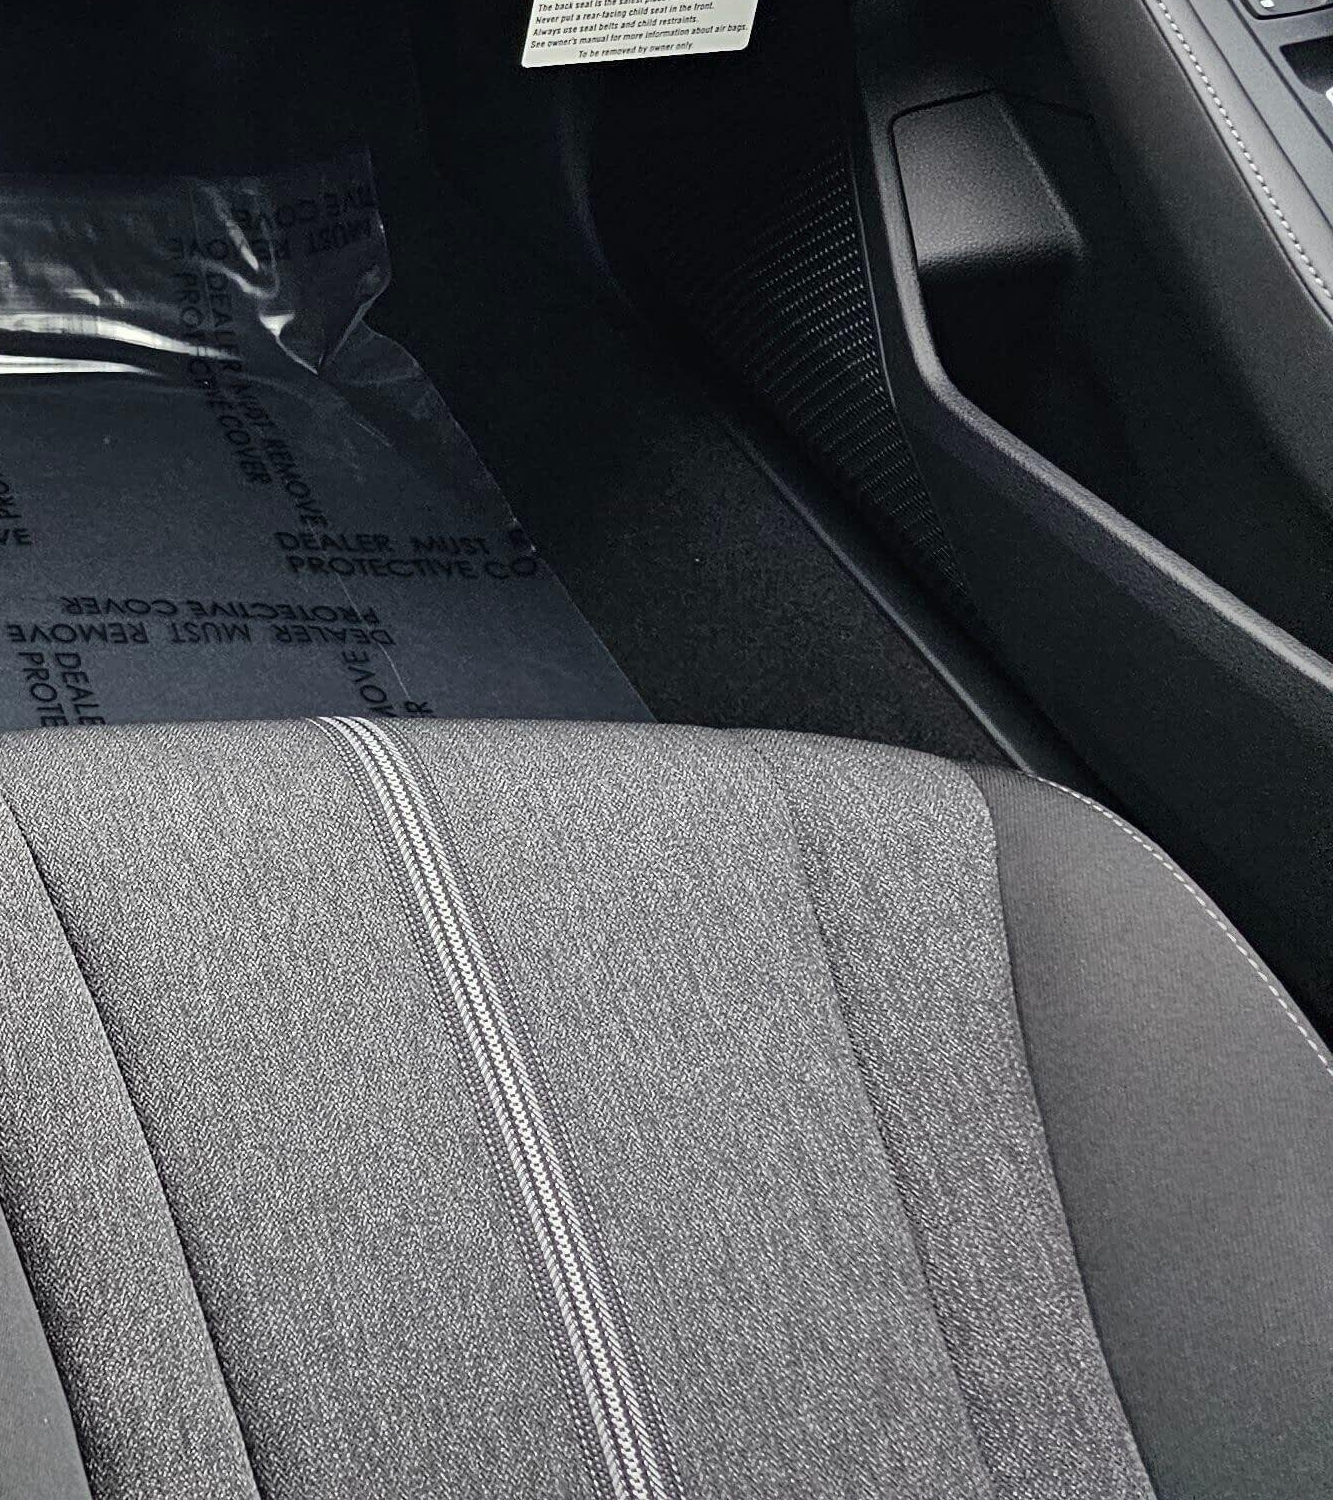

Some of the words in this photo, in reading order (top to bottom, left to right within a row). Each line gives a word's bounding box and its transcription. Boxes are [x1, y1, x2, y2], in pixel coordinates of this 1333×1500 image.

[535, 15, 558, 24] Never
[561, 13, 574, 23] put
[583, 8, 626, 20] rear-facing
[629, 7, 648, 16] child
[650, 6, 667, 14] seat
[669, 5, 677, 13] in
[679, 4, 691, 12] the
[538, 3, 552, 12] The
[555, 0, 573, 10] back
[575, 0, 593, 9] seat
[530, 39, 545, 49] See
[547, 37, 577, 47] owner's
[579, 34, 609, 44] manual
[611, 33, 621, 42] for
[623, 32, 644, 40] more
[645, 29, 689, 39] information
[691, 25, 713, 35] about
[715, 25, 726, 33] air
[727, 23, 749, 33] bags.
[533, 27, 561, 37] Always
[563, 26, 577, 34] use
[579, 23, 597, 32] seat
[599, 21, 618, 31] belts
[620, 20, 635, 29] and
[638, 18, 656, 27] child
[578, 50, 588, 58] To
[590, 49, 600, 58] be
[602, 45, 636, 56] removed
[638, 44, 647, 53] by
[649, 43, 674, 52] owner
[274, 530, 390, 553] DEALER
[410, 535, 490, 556] MUST
[286, 554, 478, 579] PROTECTIVE
[60, 596, 177, 617] COVER
[191, 601, 380, 626] PROTECTIVE
[6, 622, 149, 645] REMOVE
[170, 622, 251, 644] MUST
[275, 624, 396, 647] DEALER
